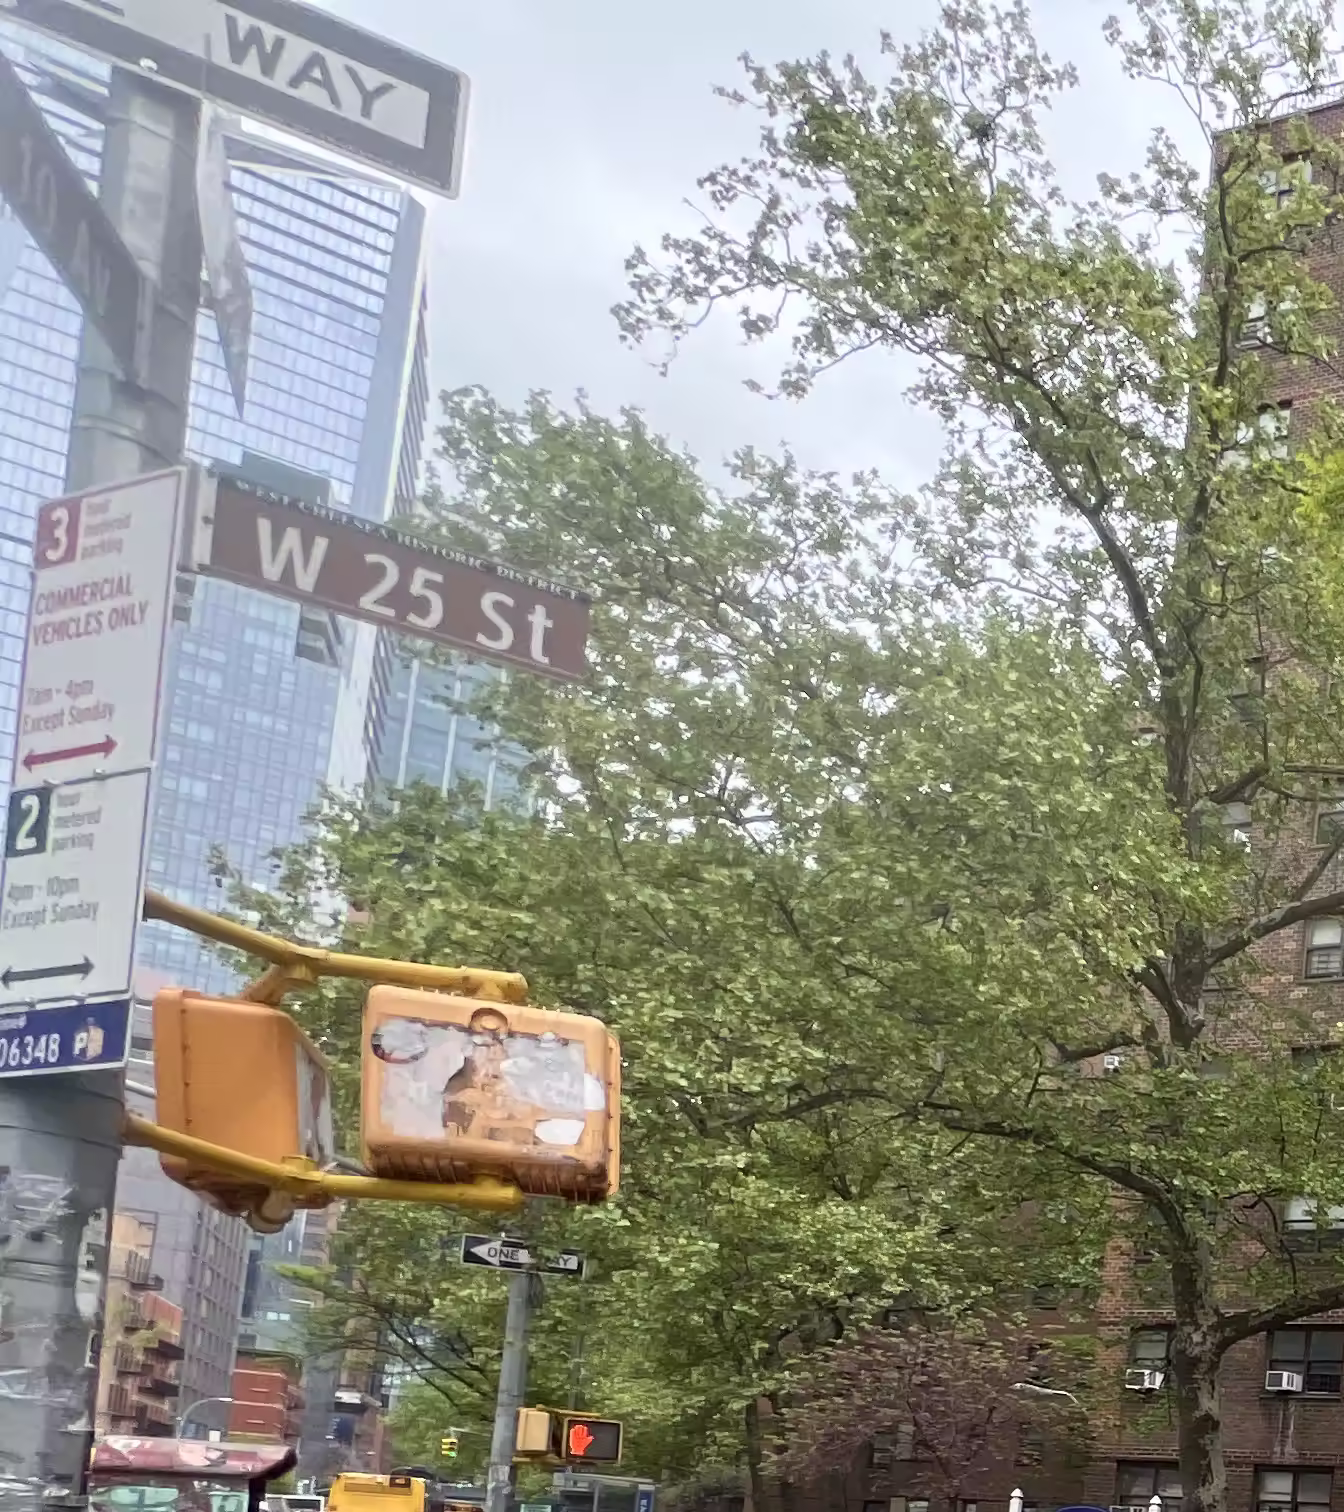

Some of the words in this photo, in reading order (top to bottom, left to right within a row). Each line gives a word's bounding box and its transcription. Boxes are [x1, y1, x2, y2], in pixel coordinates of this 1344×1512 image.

[224, 12, 399, 120] WAY
[45, 507, 69, 562] 3
[35, 572, 133, 616] COMMERCIAL
[255, 517, 329, 593] W
[359, 553, 445, 629] 25
[475, 590, 554, 665] St
[398, 532, 487, 572] HISTORIC
[496, 564, 579, 601] DISTRICT
[32, 609, 104, 646] VEHICLES
[108, 600, 150, 631] ONLY
[16, 795, 40, 850] 2
[487, 1246, 520, 1262] ONE
